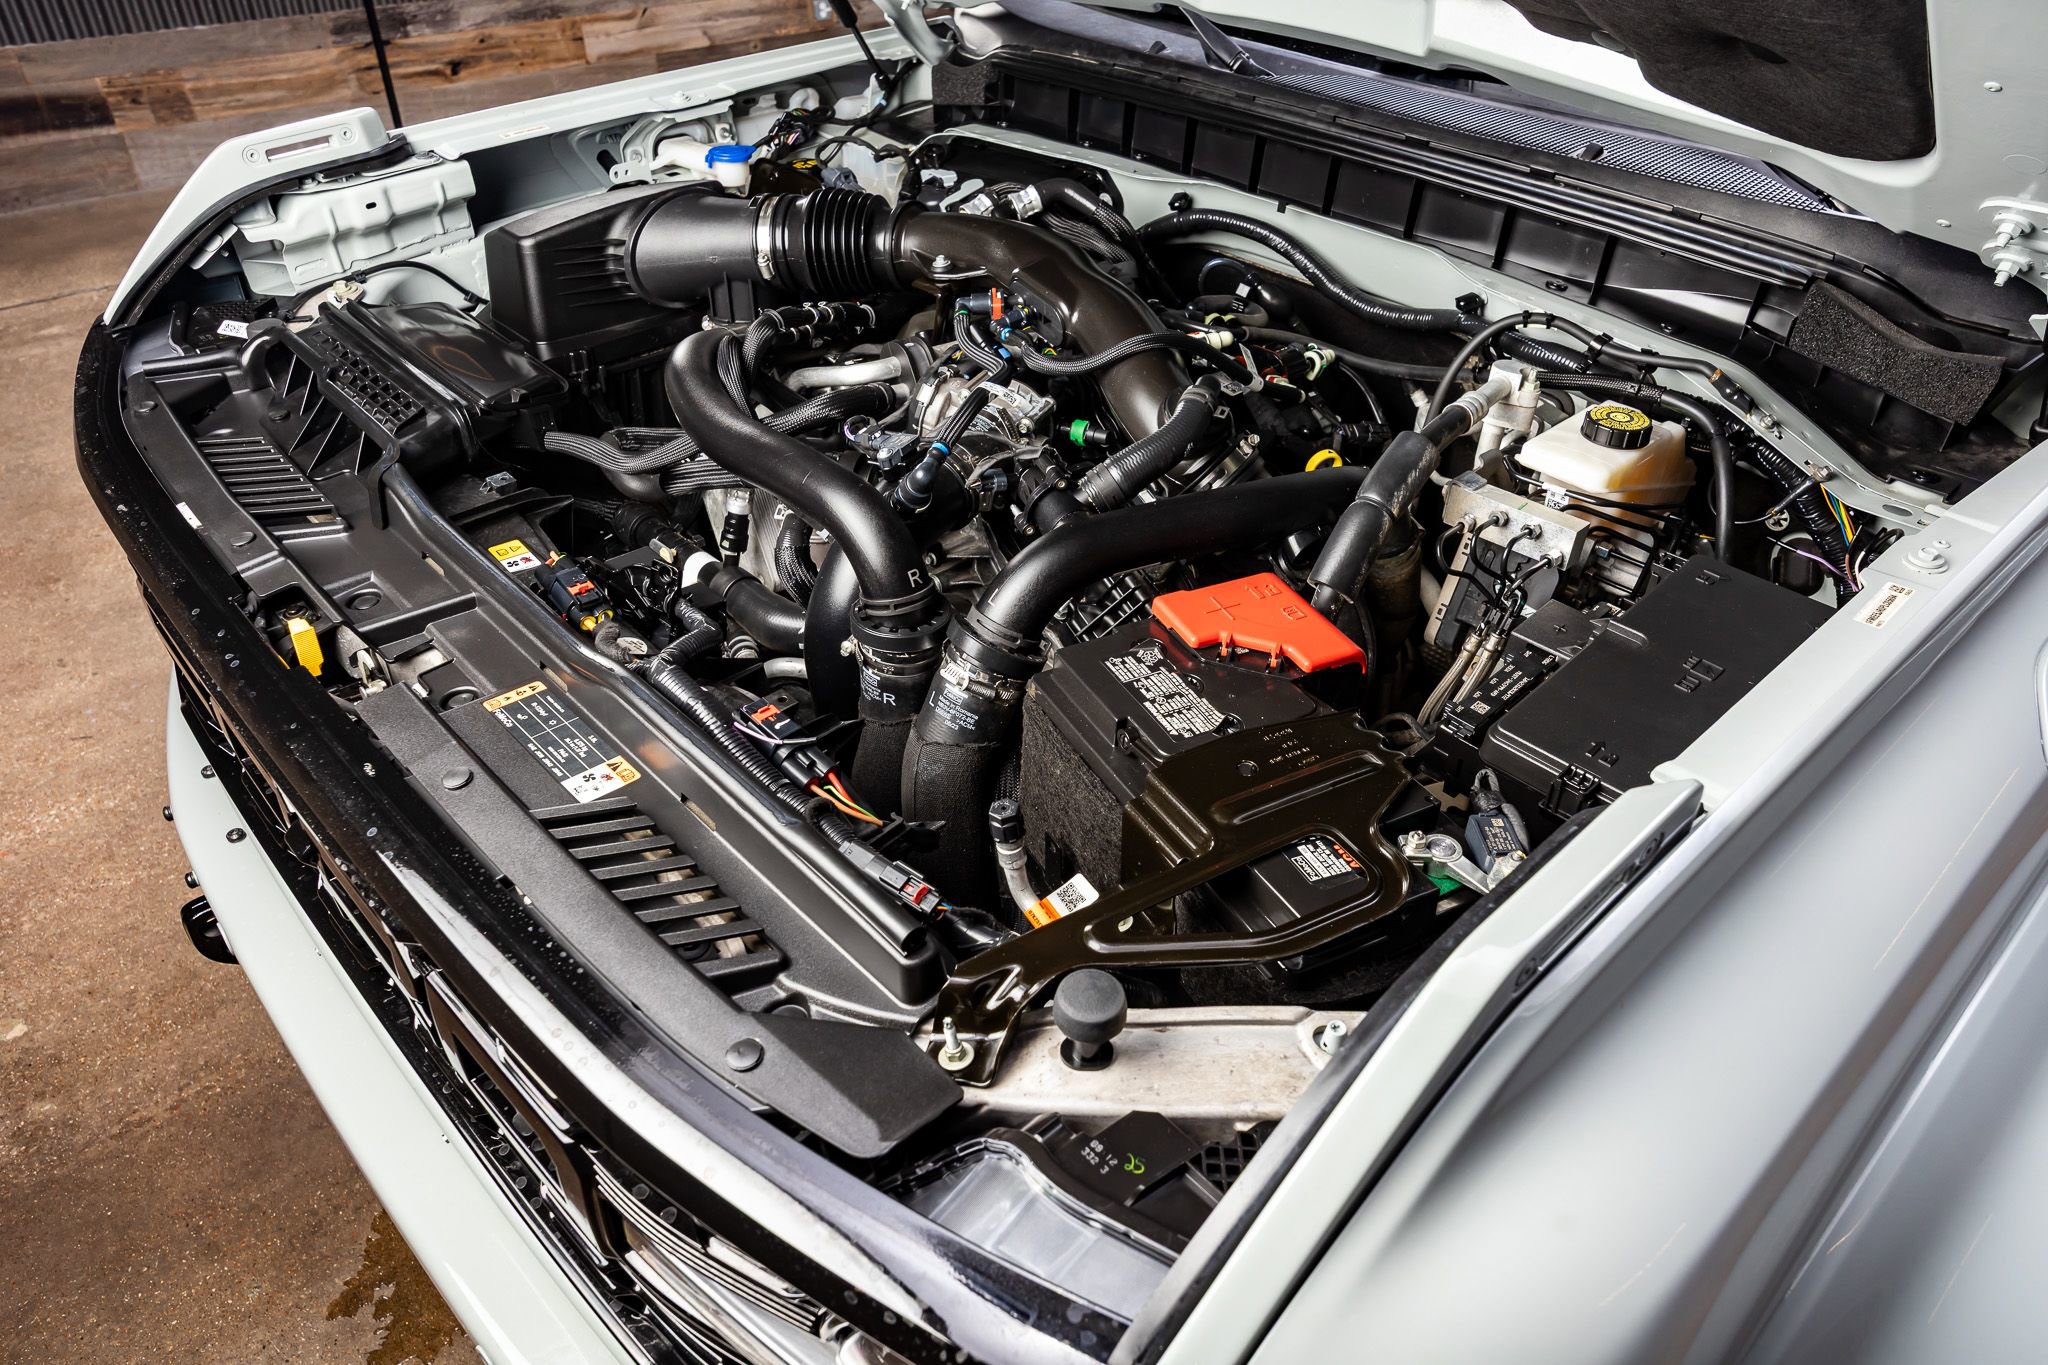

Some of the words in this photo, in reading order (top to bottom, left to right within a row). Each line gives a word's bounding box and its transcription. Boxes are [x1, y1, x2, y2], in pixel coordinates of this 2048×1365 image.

[907, 568, 923, 588] R
[987, 588, 999, 607] L
[883, 692, 896, 706] R
[929, 691, 935, 707] L
